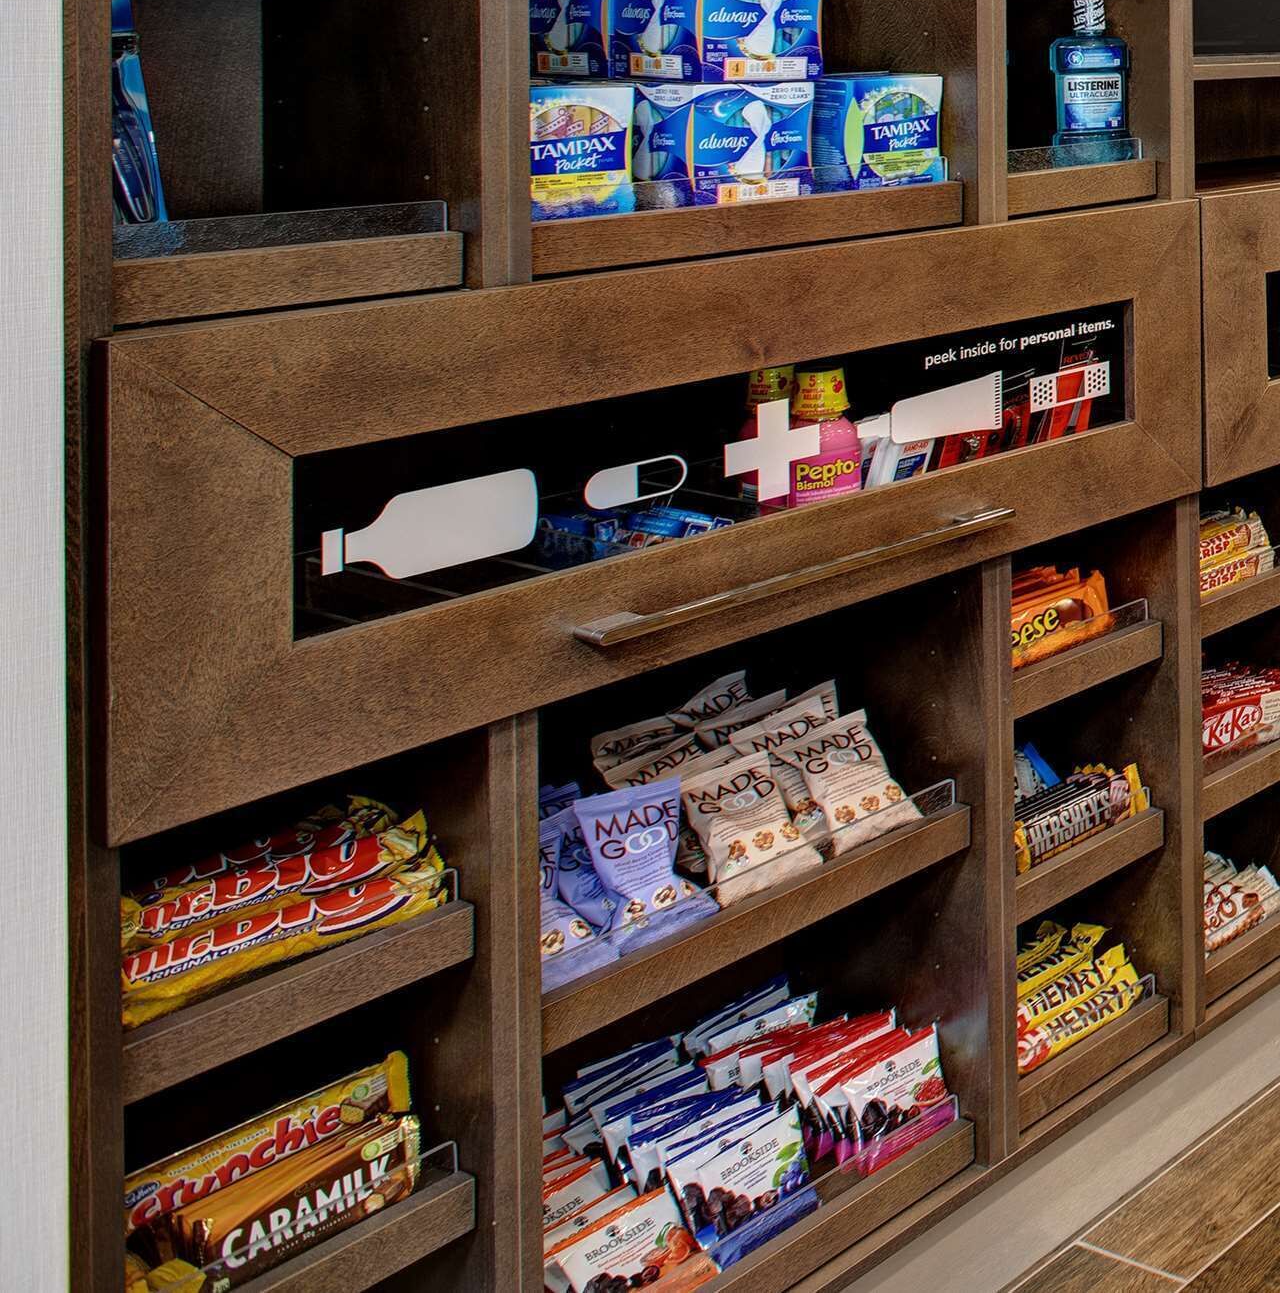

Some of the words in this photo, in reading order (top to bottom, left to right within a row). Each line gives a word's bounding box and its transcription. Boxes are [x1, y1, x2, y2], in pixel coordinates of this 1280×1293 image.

[621, 3, 650, 24] always
[708, 7, 759, 27] always
[1068, 80, 1119, 91] LISTERINE
[1069, 90, 1119, 99] ULTRACLEAN
[871, 119, 931, 140] TAMPAX
[530, 136, 616, 160] TAMPAX
[699, 133, 750, 153] always
[889, 134, 920, 151] Pocket
[555, 153, 602, 174] Pocket
[925, 348, 957, 370] peek
[960, 341, 997, 361] inside
[1000, 336, 1018, 351] for
[1020, 323, 1075, 349] personal
[1078, 319, 1115, 335] items.
[796, 459, 859, 483] Pepto-
[796, 477, 835, 491] Bismol
[1200, 525, 1245, 549] OFFEE
[752, 715, 824, 753] MADE
[794, 725, 865, 761] MADE
[688, 767, 766, 804] MADE
[595, 798, 678, 841] MADE
[130, 1104, 342, 1228] Crunchie
[720, 1138, 779, 1181] BROOKSIDE
[221, 1154, 392, 1269] CARAMILK
[544, 1196, 585, 1225] OKSIDE
[584, 1217, 655, 1261] BROOKSIDE
